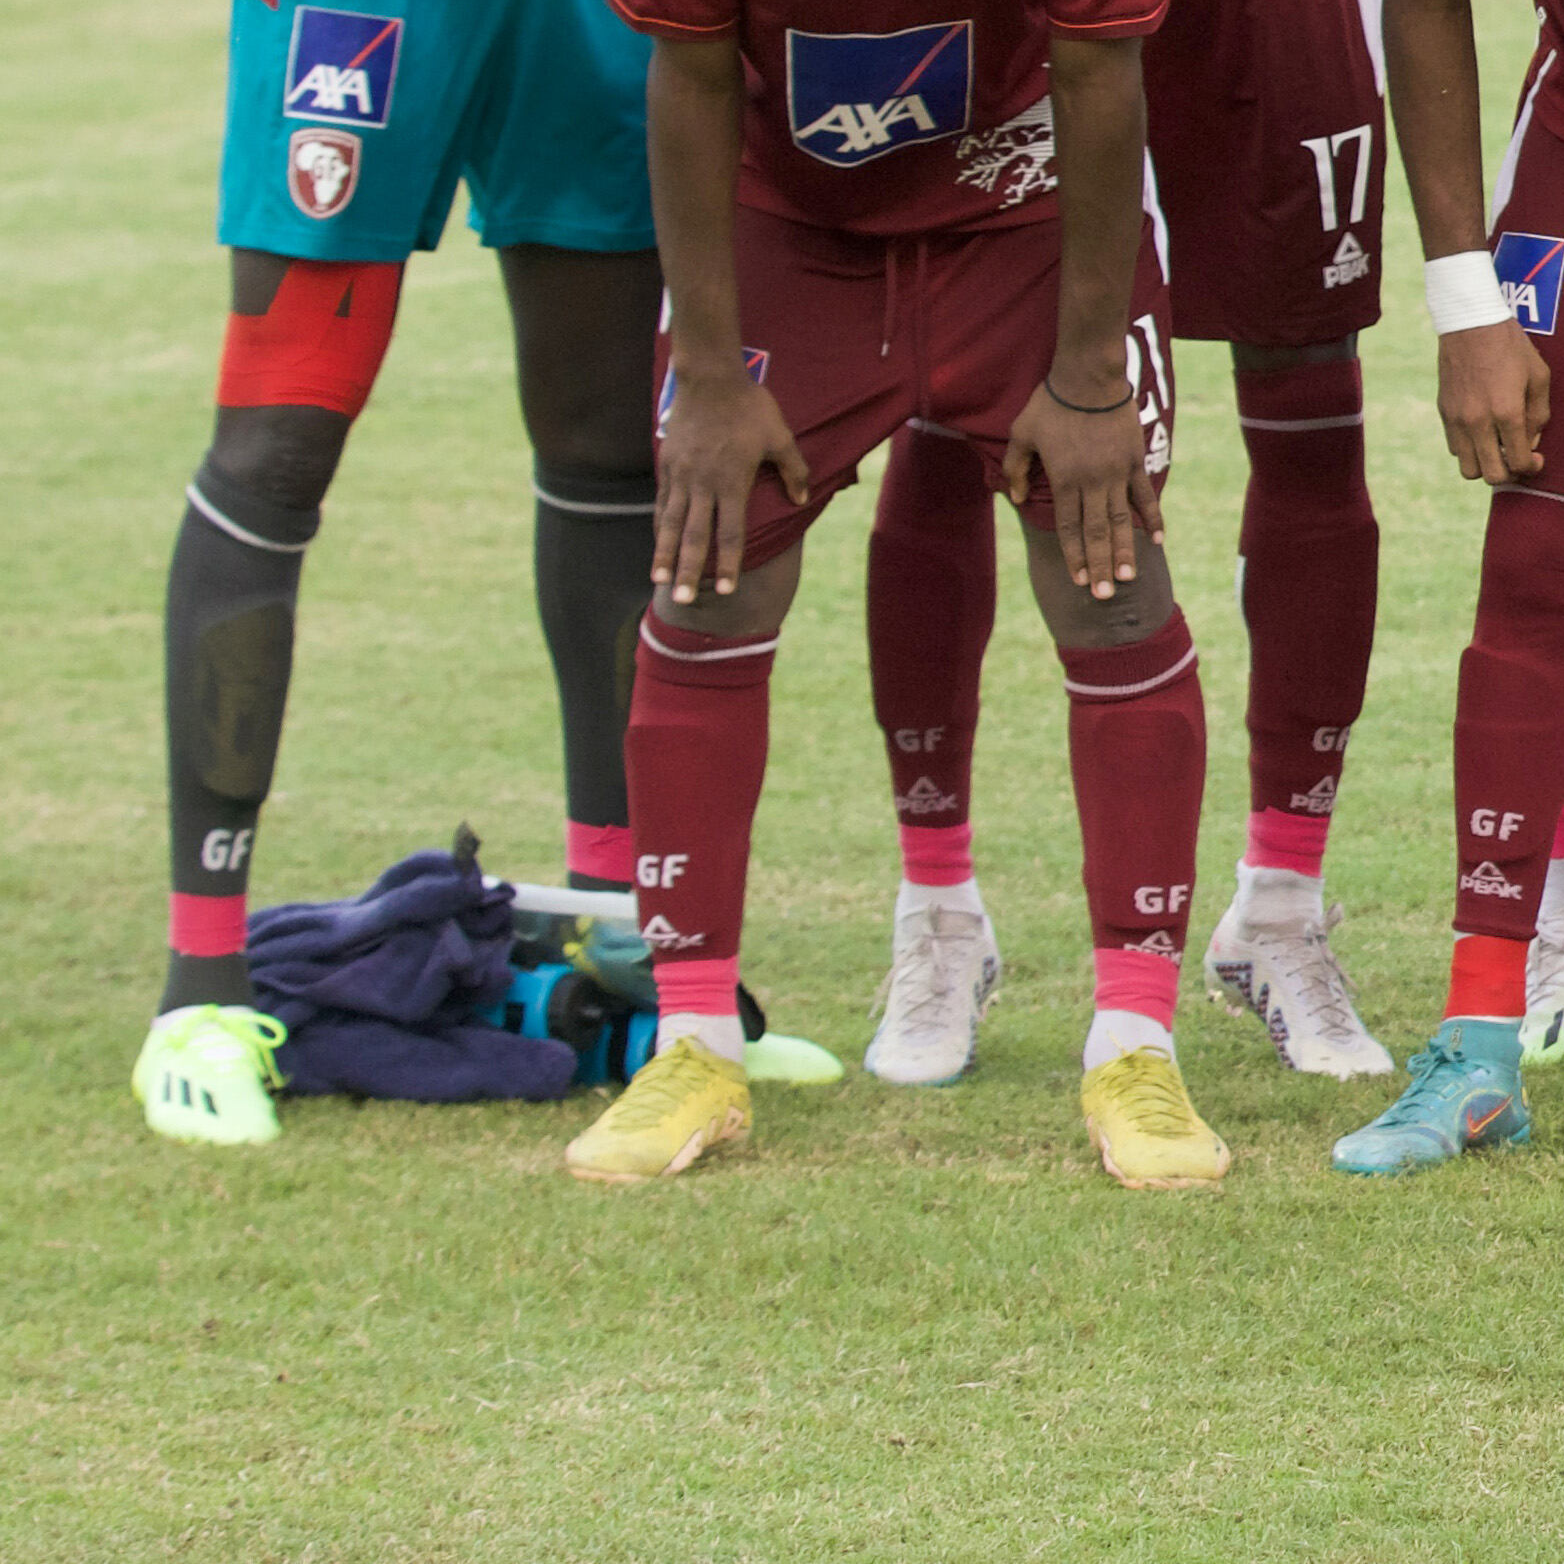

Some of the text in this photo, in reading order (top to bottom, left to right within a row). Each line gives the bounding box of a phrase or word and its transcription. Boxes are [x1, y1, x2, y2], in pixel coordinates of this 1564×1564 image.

[285, 64, 372, 114] AXA
[796, 93, 936, 153] AXA
[1300, 125, 1373, 231] 17
[1322, 253, 1370, 289] PEAK
[895, 727, 944, 752] GF
[1290, 793, 1336, 814] PEA
[1469, 807, 1524, 841] GF
[637, 854, 689, 889] GF
[1460, 875, 1523, 901] PEAK
[1134, 884, 1189, 915] GF
